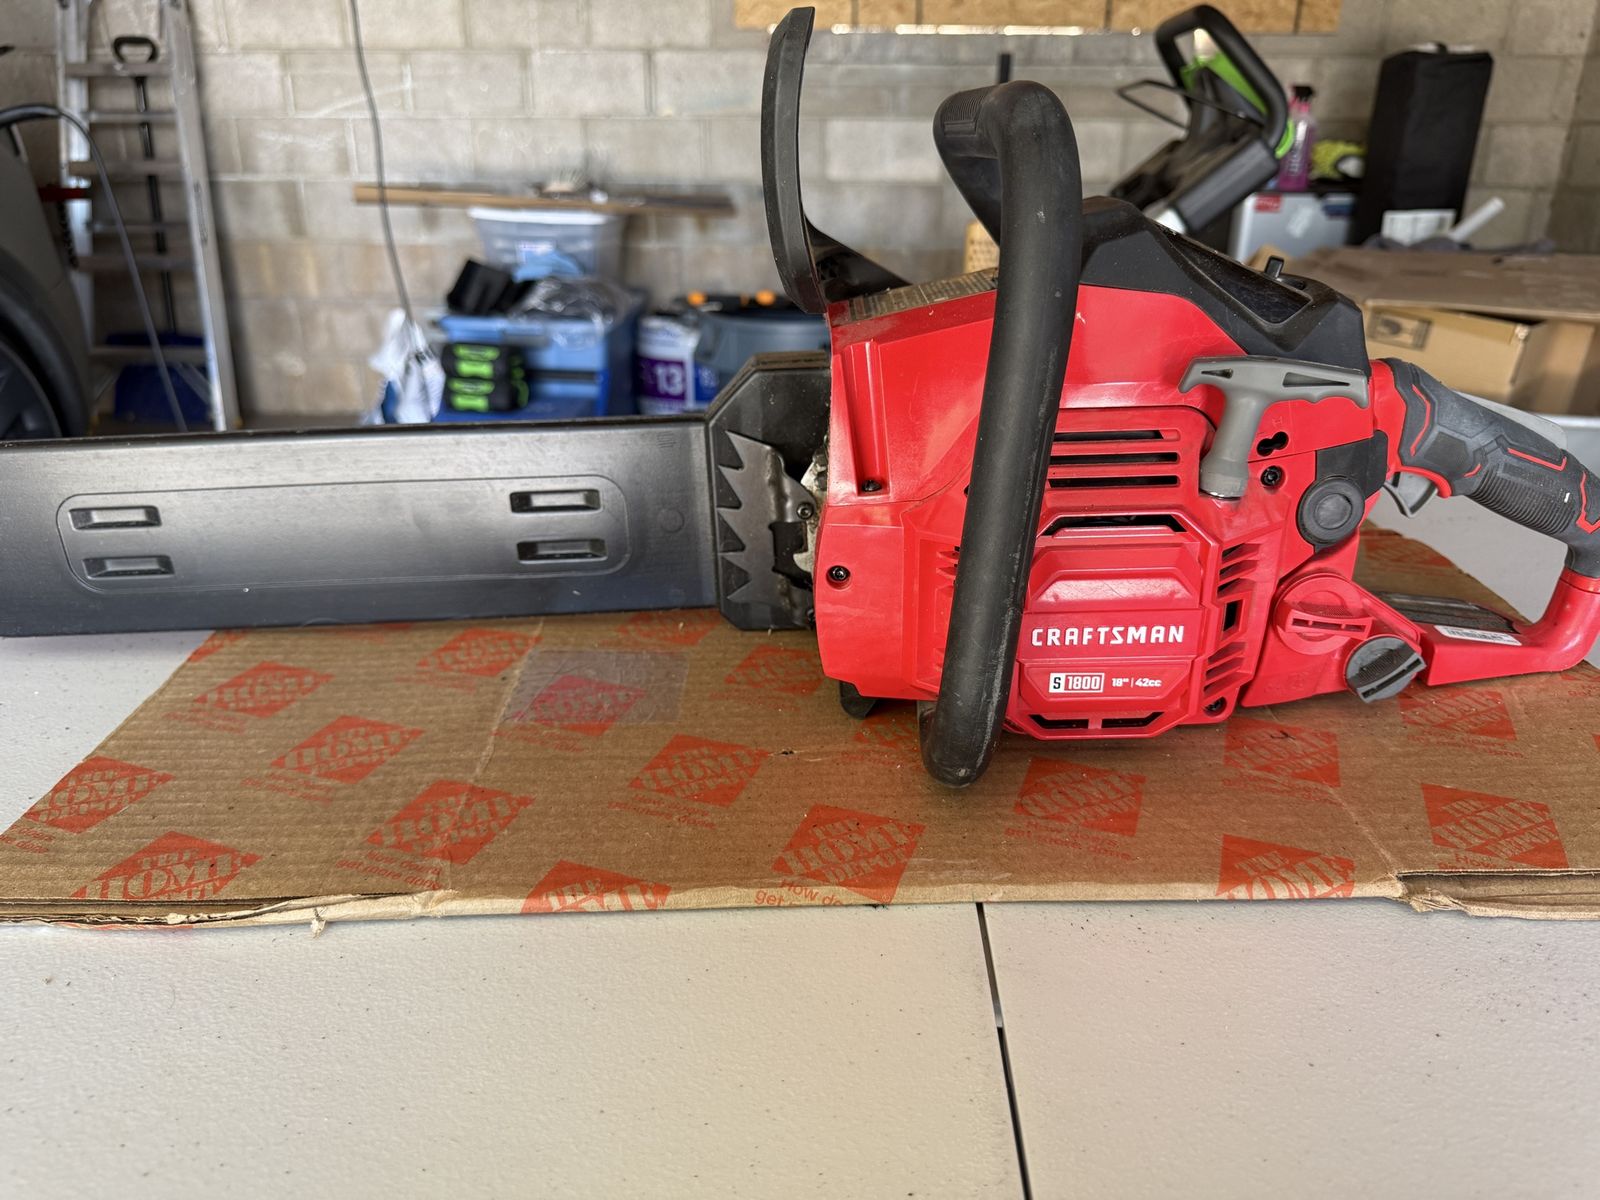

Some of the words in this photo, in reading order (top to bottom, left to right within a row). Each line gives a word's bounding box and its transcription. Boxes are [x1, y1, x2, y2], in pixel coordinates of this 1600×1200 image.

[656, 363, 685, 396] 13
[1031, 625, 1185, 646] CRAFTSMAN
[1067, 675, 1101, 690] 1800
[1135, 677, 1162, 687] 42cc
[1440, 798, 1492, 819] THE
[1432, 800, 1549, 850] HOME
[781, 821, 914, 876] HOME
[1486, 824, 1560, 860] DEPOT
[1234, 850, 1290, 877] THE
[779, 879, 819, 901] How
